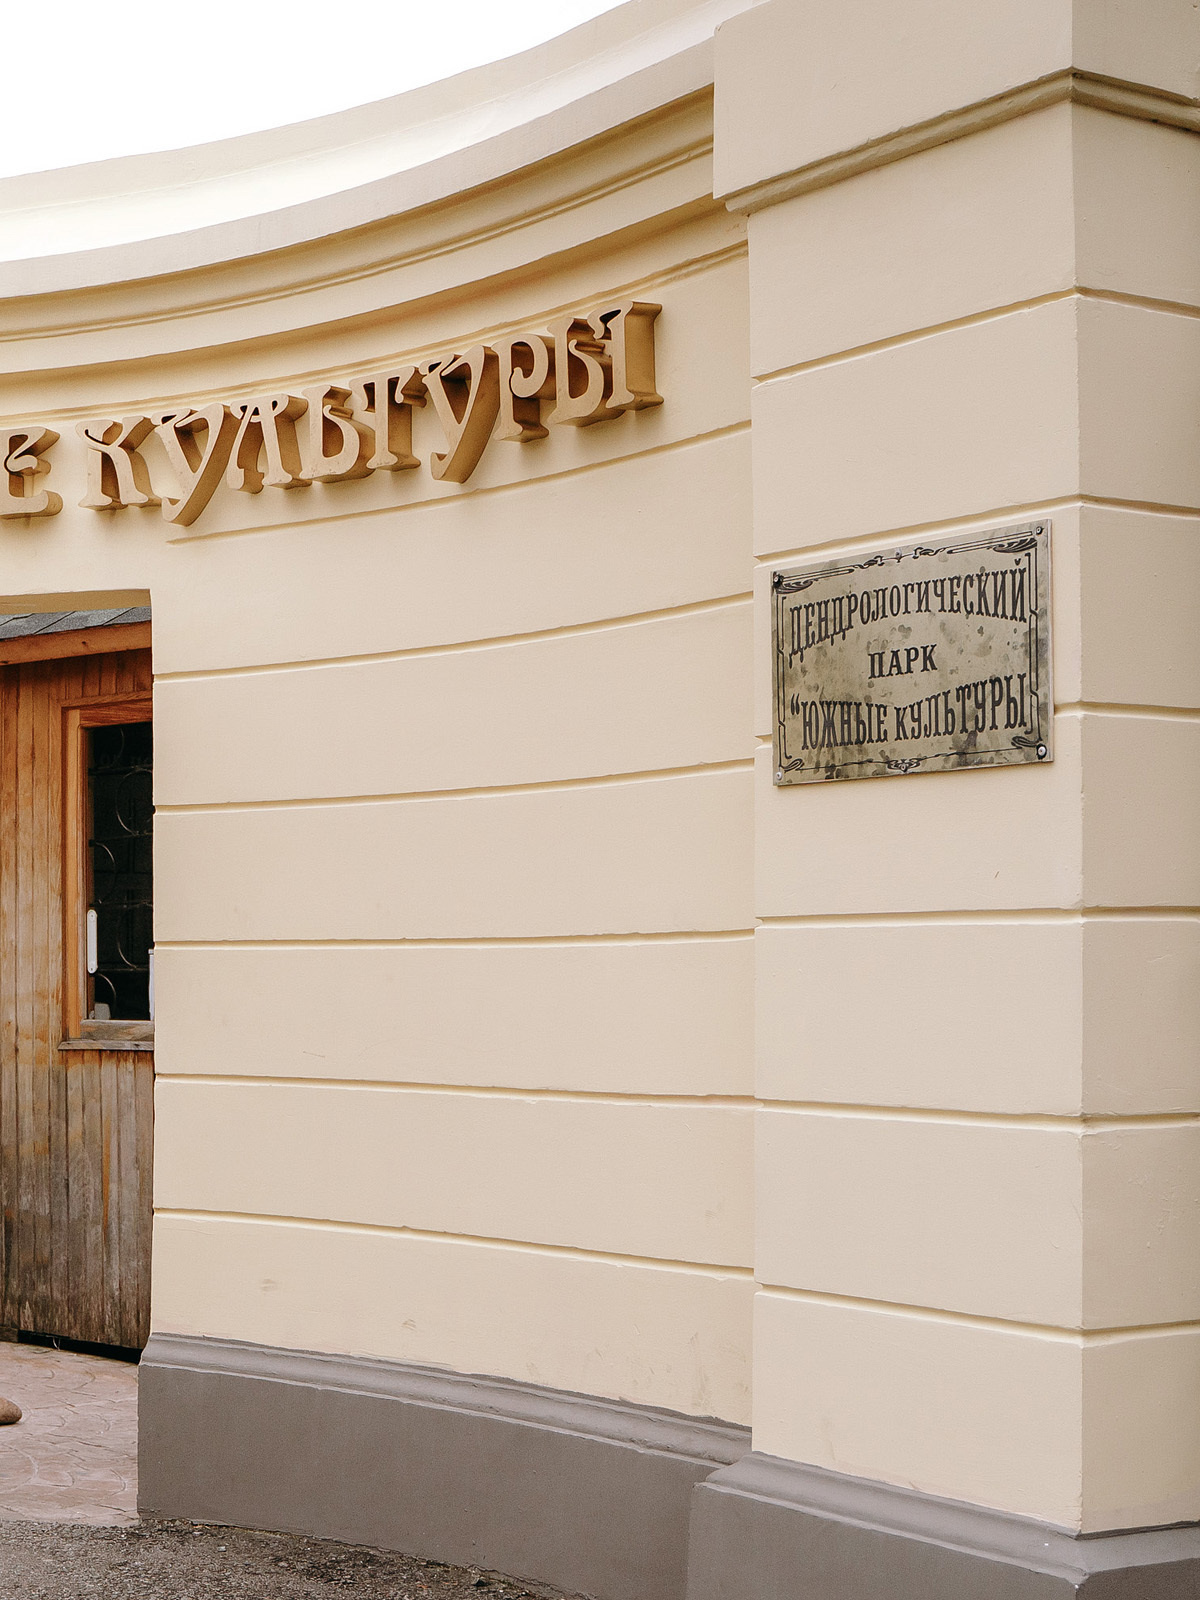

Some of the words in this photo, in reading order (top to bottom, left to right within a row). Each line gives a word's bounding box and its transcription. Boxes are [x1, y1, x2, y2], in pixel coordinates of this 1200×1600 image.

[76, 300, 664, 526] КУЛЬТУРЫ
[788, 558, 1028, 668] ДЕНДРОЛОГИЧЕСКИЙ
[868, 644, 938, 679] ПАРК
[894, 672, 1028, 741] КУЛЬТУРЫ
